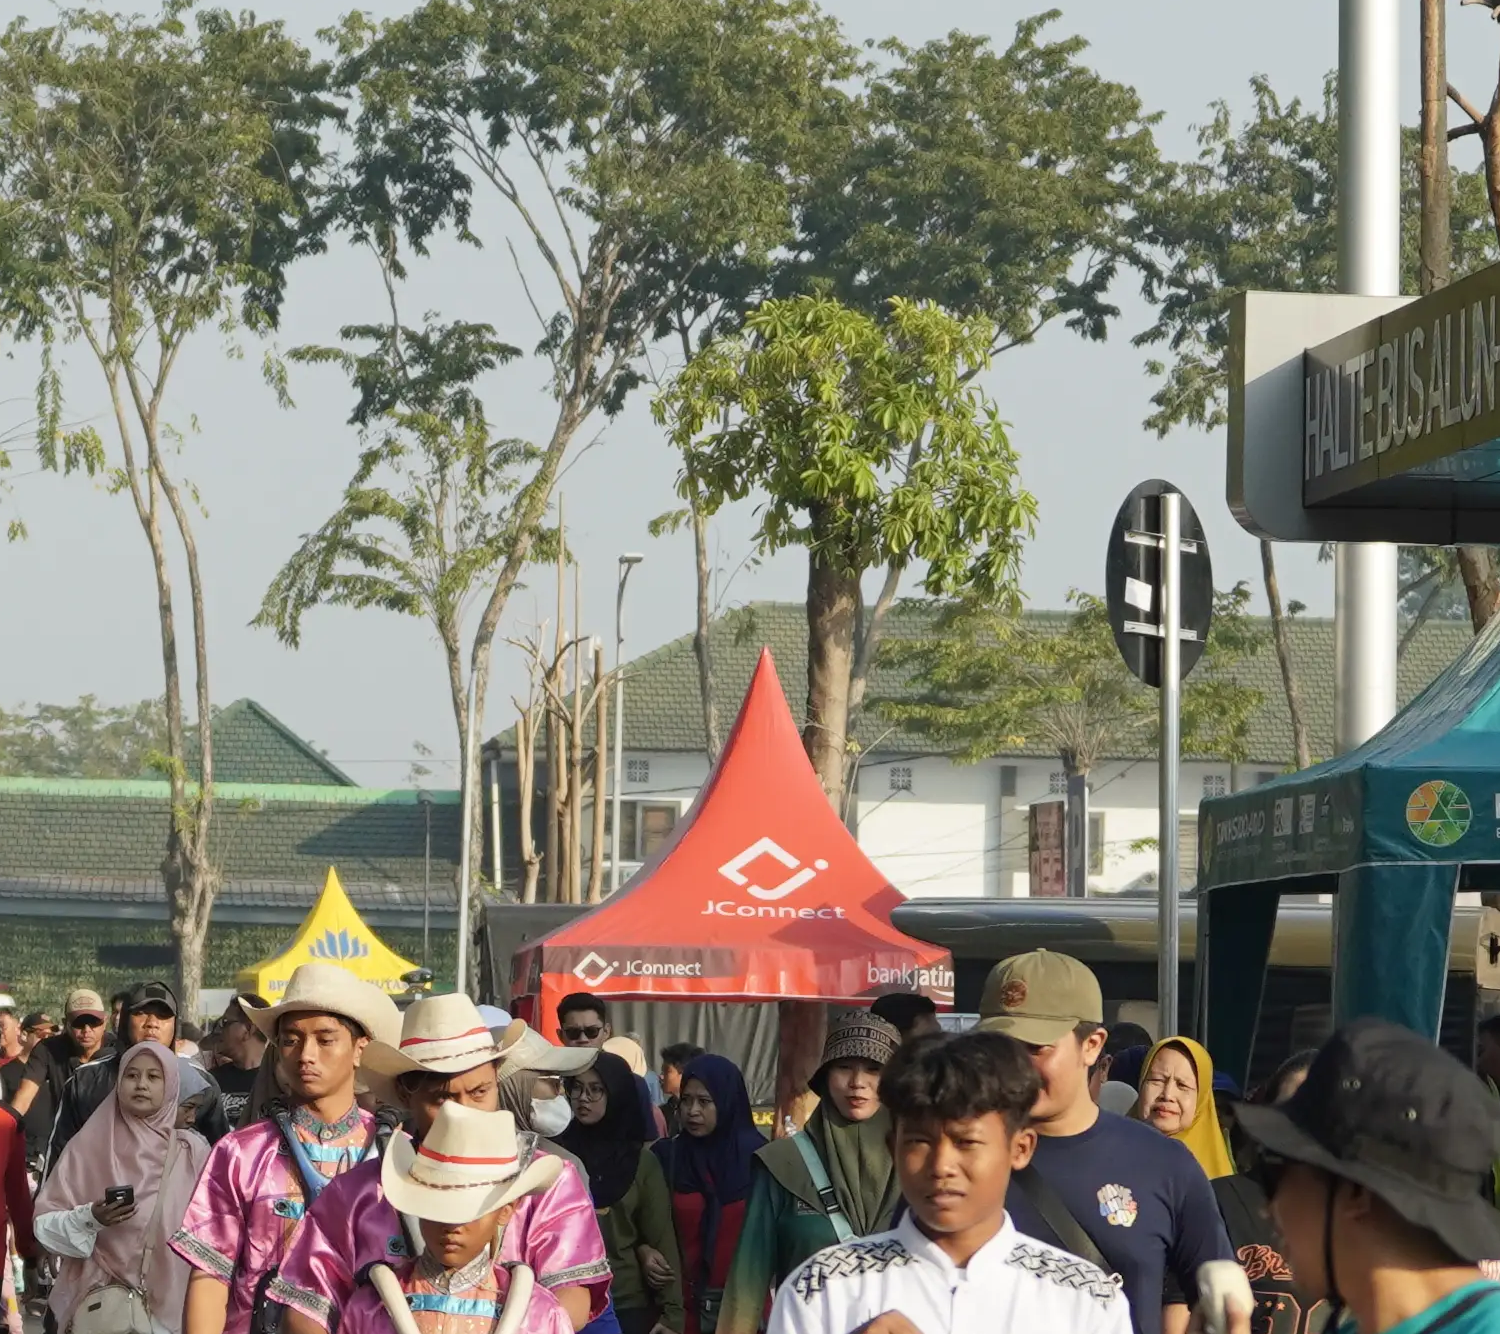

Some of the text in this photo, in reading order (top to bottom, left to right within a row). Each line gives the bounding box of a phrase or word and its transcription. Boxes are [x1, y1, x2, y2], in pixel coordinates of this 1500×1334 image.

[1305, 348, 1377, 481] HALTE
[1376, 326, 1425, 454] BUS
[701, 900, 846, 920] JConnect
[622, 960, 702, 977] JConnect
